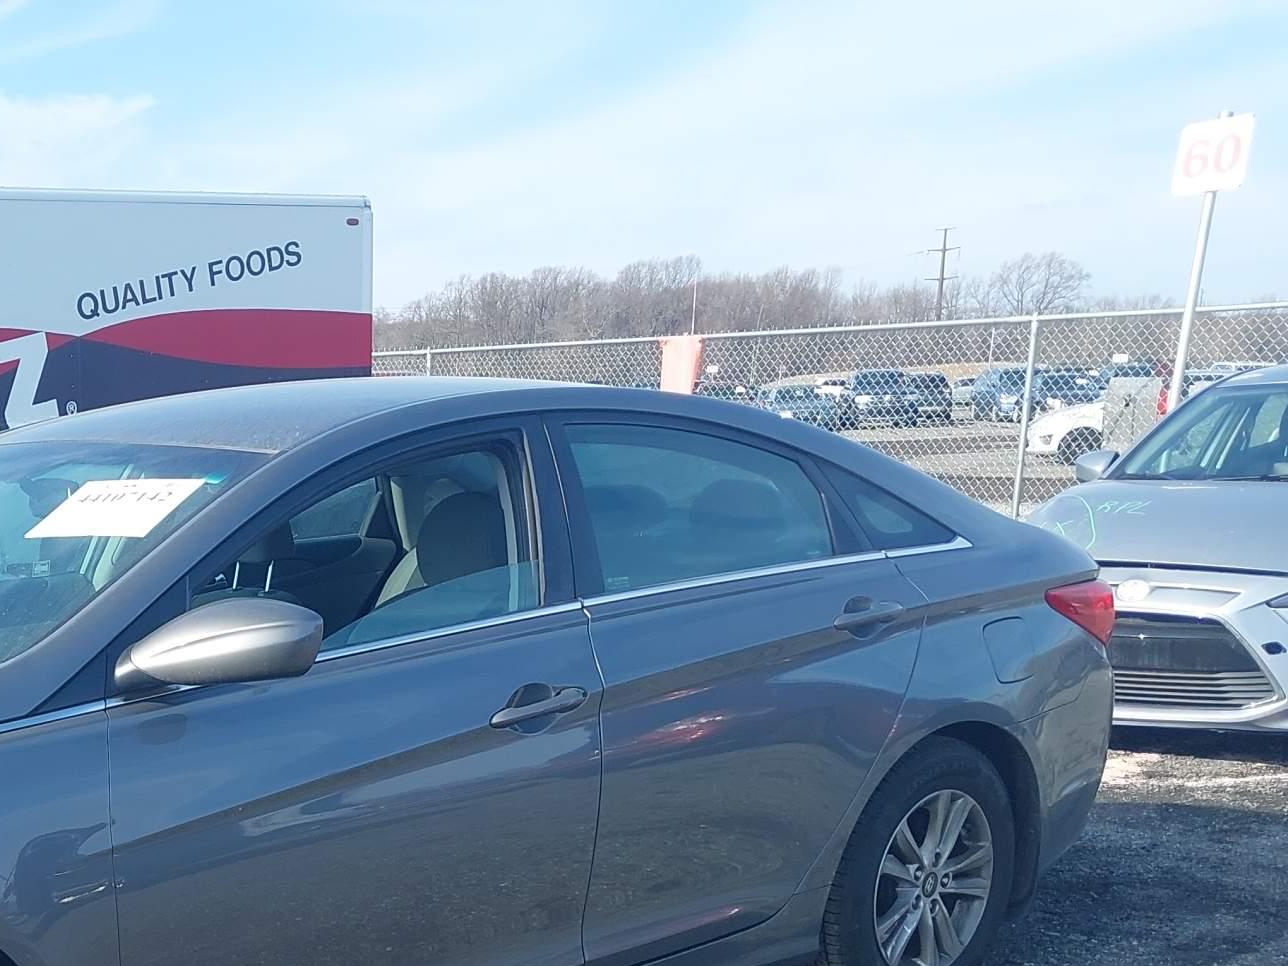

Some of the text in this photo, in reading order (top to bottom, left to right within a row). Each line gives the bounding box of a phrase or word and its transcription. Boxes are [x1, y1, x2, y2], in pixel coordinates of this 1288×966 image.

[1182, 132, 1242, 179] 60
[77, 241, 303, 320] QUALITY FOODS
